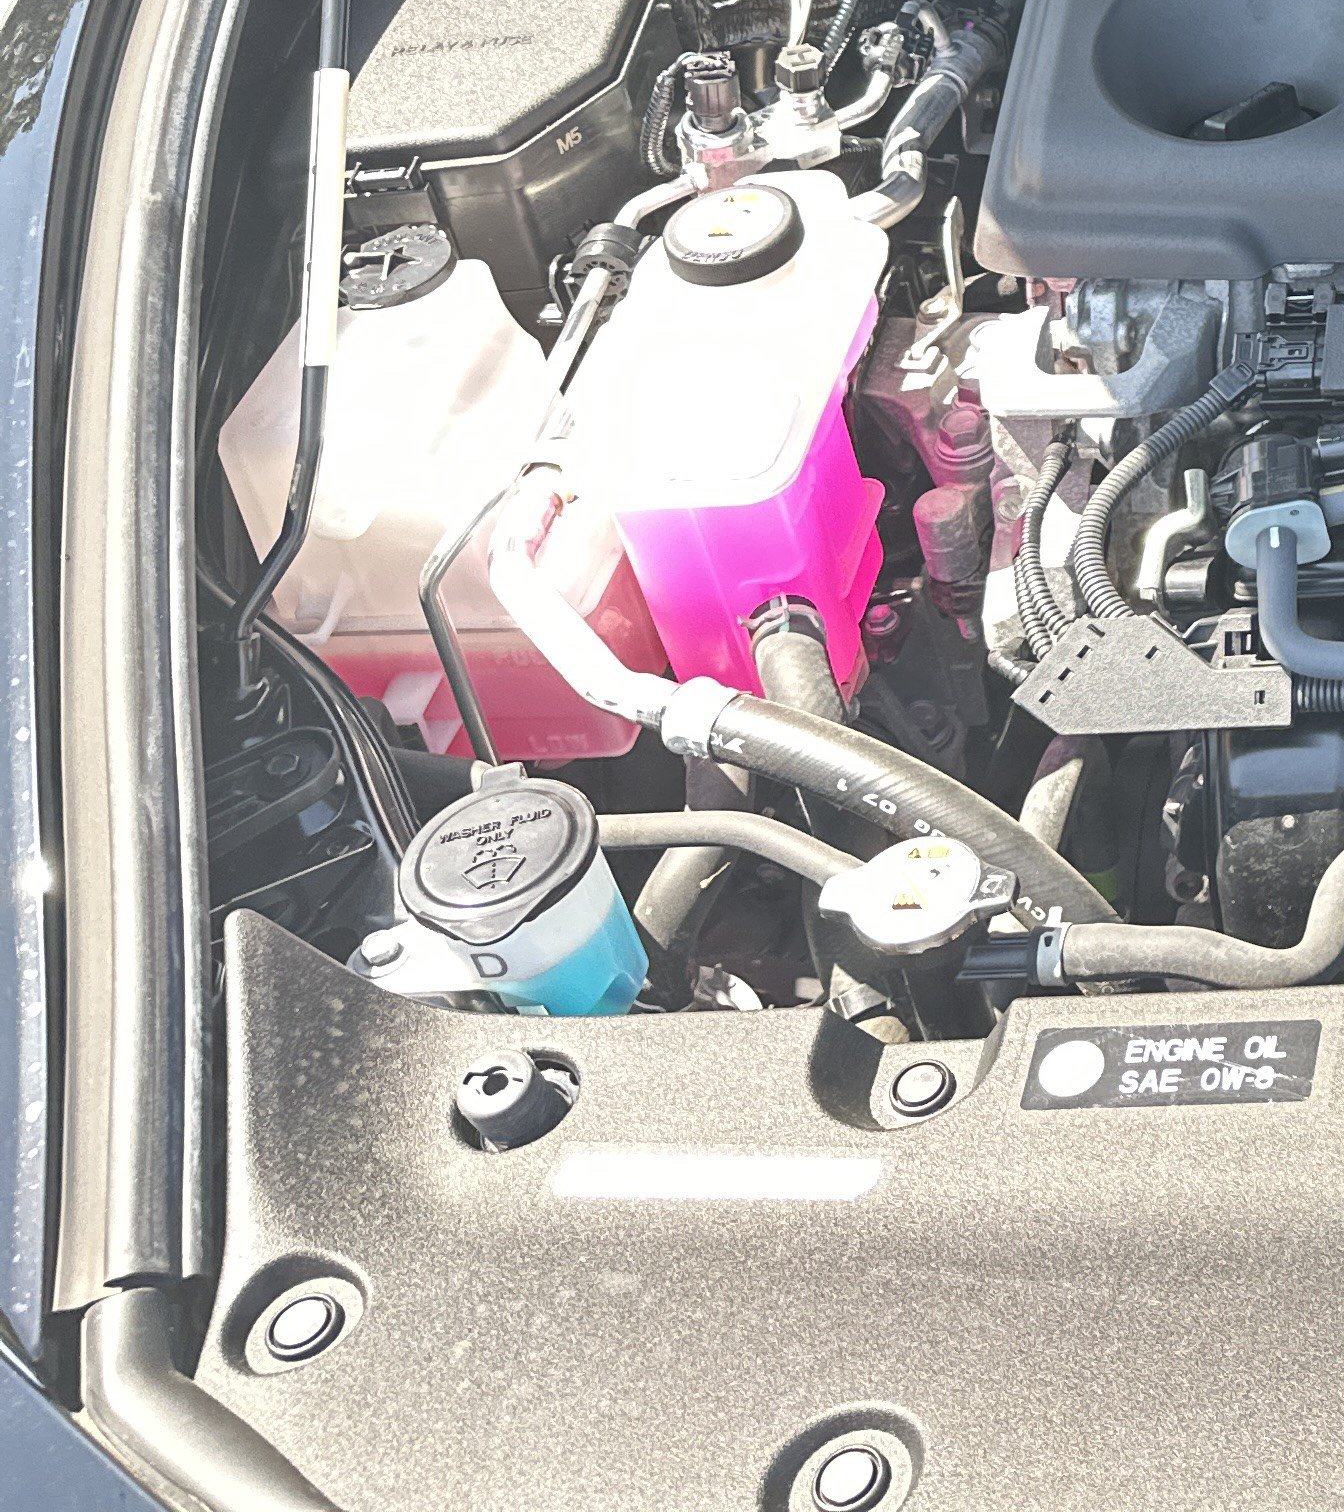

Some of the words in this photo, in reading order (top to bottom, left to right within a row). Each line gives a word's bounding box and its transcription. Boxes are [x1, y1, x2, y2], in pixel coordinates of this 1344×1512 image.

[556, 125, 582, 155] M5
[440, 821, 502, 845] WASHER
[510, 809, 552, 827] FLUID
[476, 829, 514, 846] ONLY
[470, 952, 508, 978] D
[1124, 1037, 1227, 1064] ENGINE
[1244, 1035, 1287, 1061] OIL
[1118, 1068, 1182, 1094] SAE
